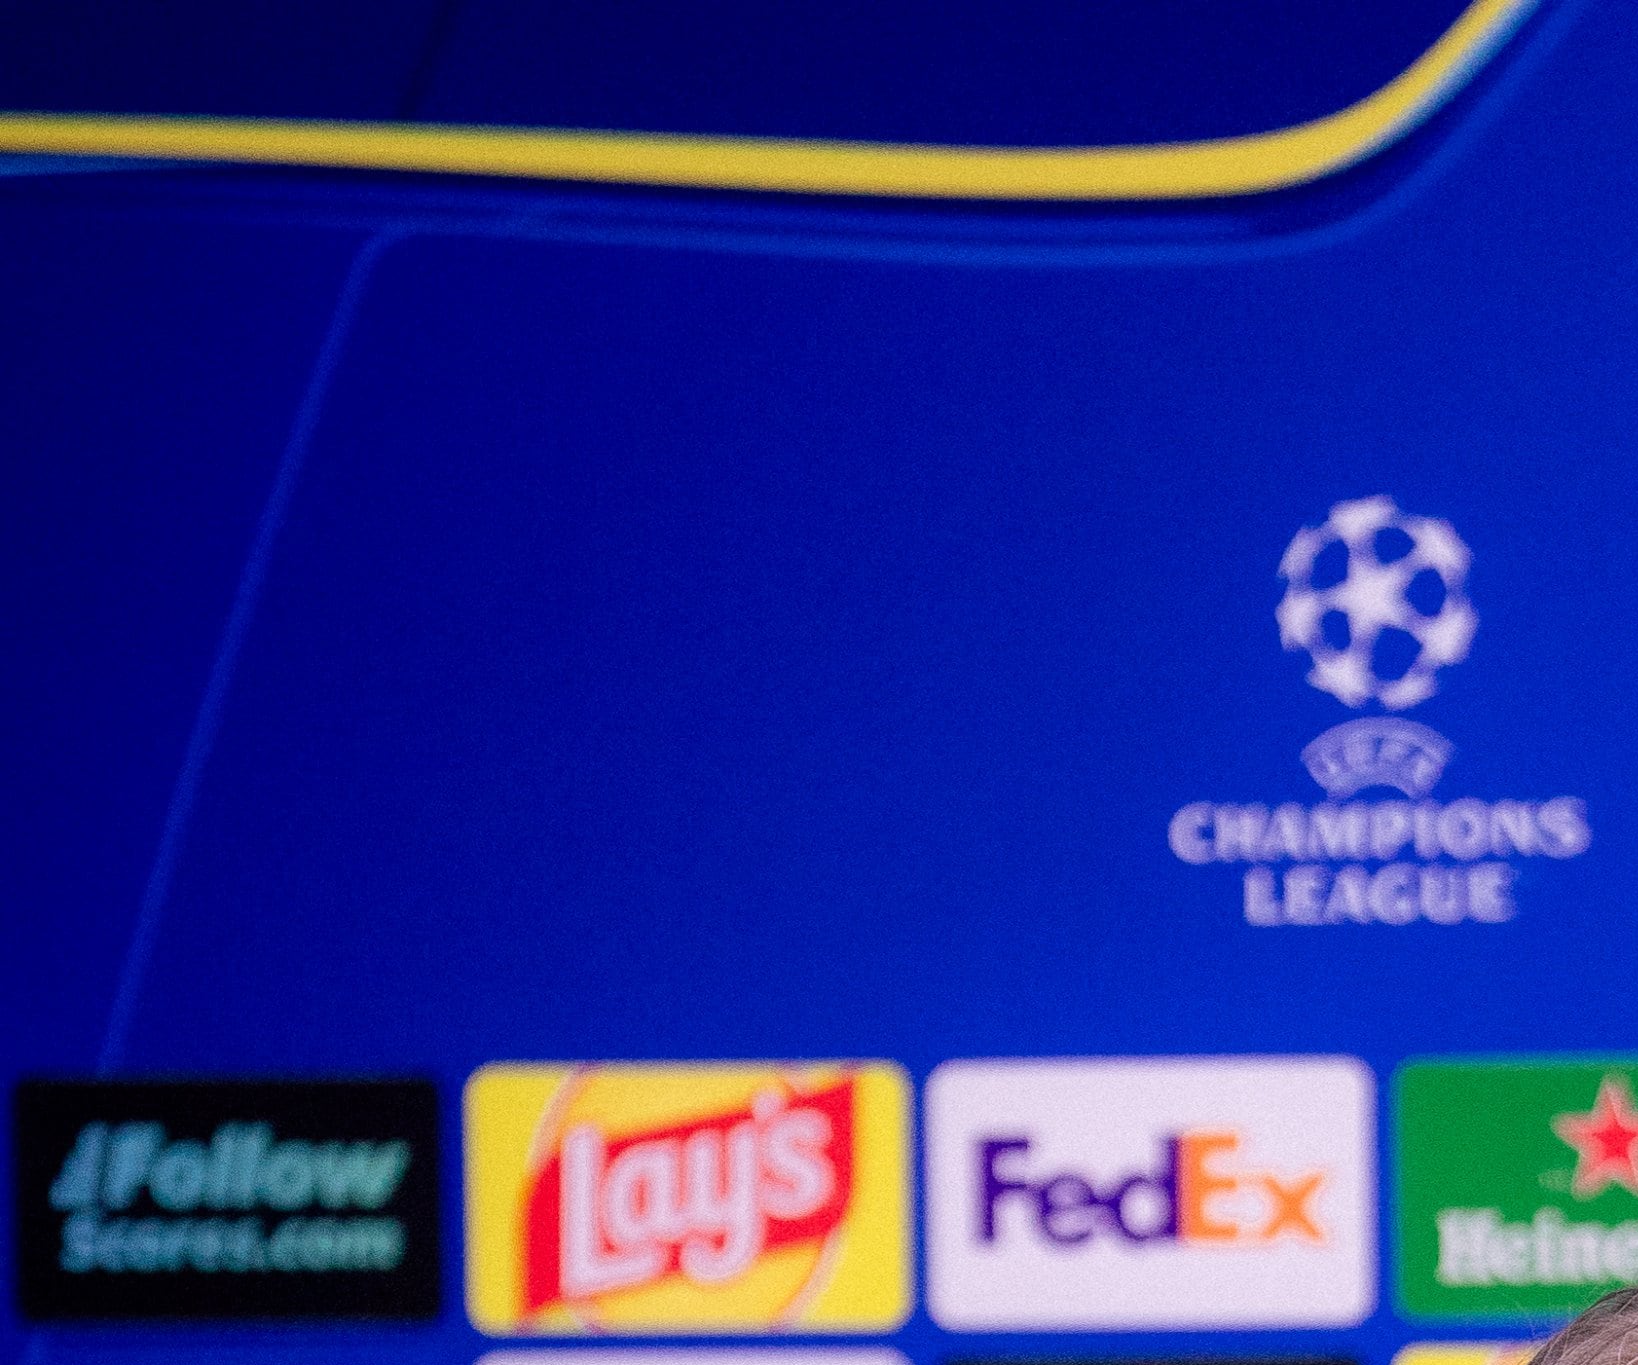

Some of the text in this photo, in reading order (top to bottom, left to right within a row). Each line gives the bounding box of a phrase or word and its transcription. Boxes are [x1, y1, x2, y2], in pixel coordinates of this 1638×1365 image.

[1170, 798, 1591, 864] CHAMPIONS
[1243, 862, 1517, 926] LEAGUE
[560, 1088, 834, 1298] Lay's
[978, 1132, 1328, 1246] FedEx
[60, 1214, 405, 1272] Scores.com
